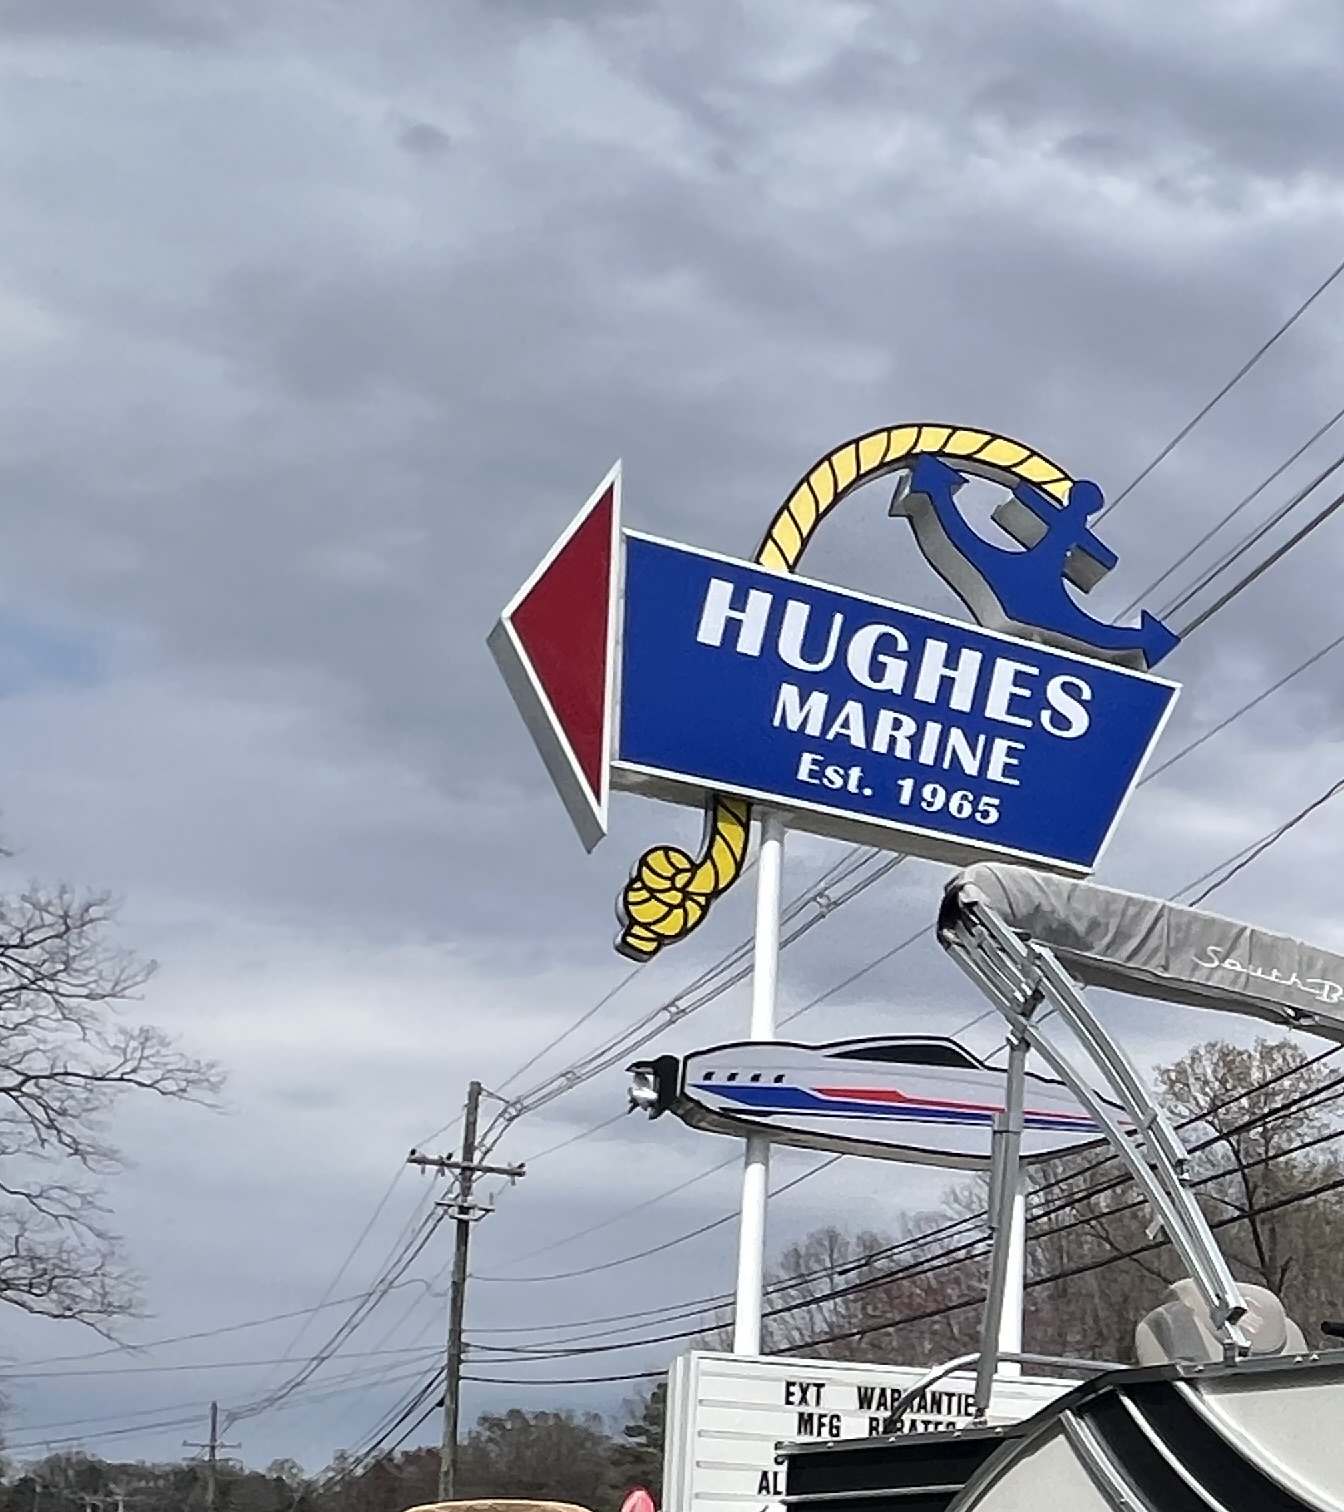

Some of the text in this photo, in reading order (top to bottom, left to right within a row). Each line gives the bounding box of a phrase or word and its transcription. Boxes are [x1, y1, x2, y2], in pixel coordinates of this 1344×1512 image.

[695, 577, 1093, 740] HUGHES
[772, 682, 1024, 786] MARINE
[796, 752, 1000, 826] Est. 1965
[1191, 945, 1303, 986] South
[784, 1379, 826, 1408] EXT
[797, 1412, 842, 1438] MFG
